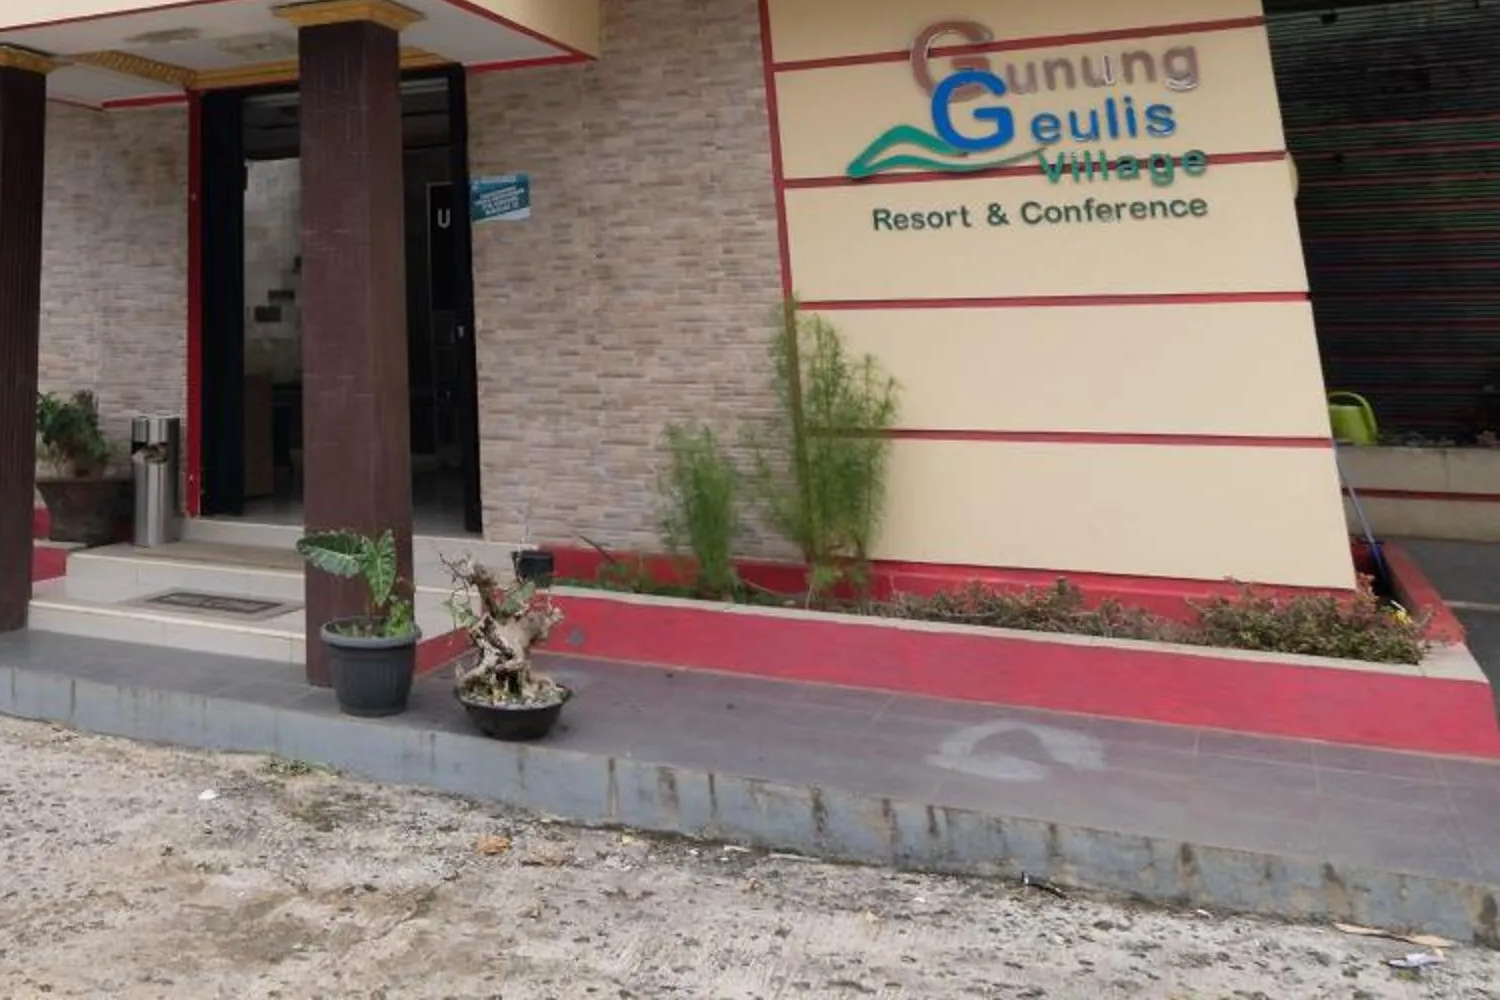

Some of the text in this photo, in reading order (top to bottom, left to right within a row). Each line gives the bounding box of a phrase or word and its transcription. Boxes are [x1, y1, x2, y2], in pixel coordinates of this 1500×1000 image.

[910, 20, 1200, 102] Gunung
[931, 68, 1176, 152] Geulis
[1038, 149, 1209, 187] Village
[872, 197, 1209, 231] Resort & Conference
